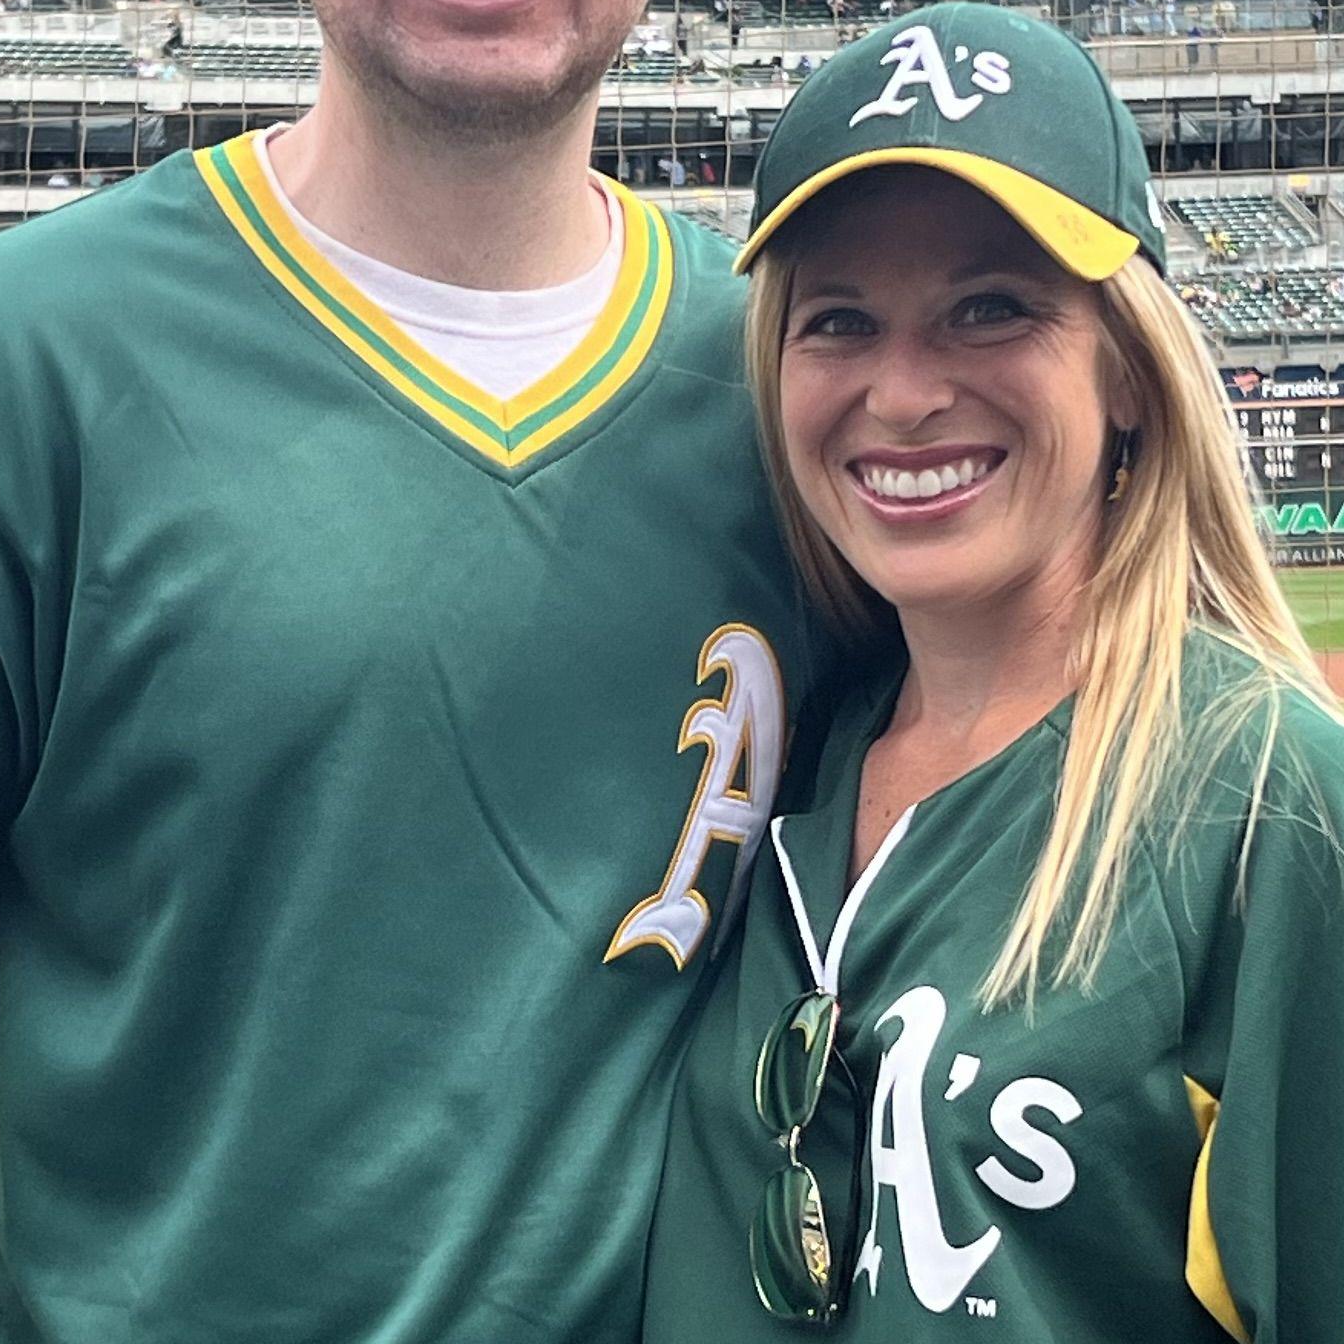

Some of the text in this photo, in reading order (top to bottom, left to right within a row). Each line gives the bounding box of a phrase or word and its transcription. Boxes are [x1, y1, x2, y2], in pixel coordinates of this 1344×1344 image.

[849, 25, 1013, 128] A's
[1261, 376, 1340, 399] Fanatics
[853, 985, 1084, 1314] A's
[965, 1296, 997, 1318] TM
